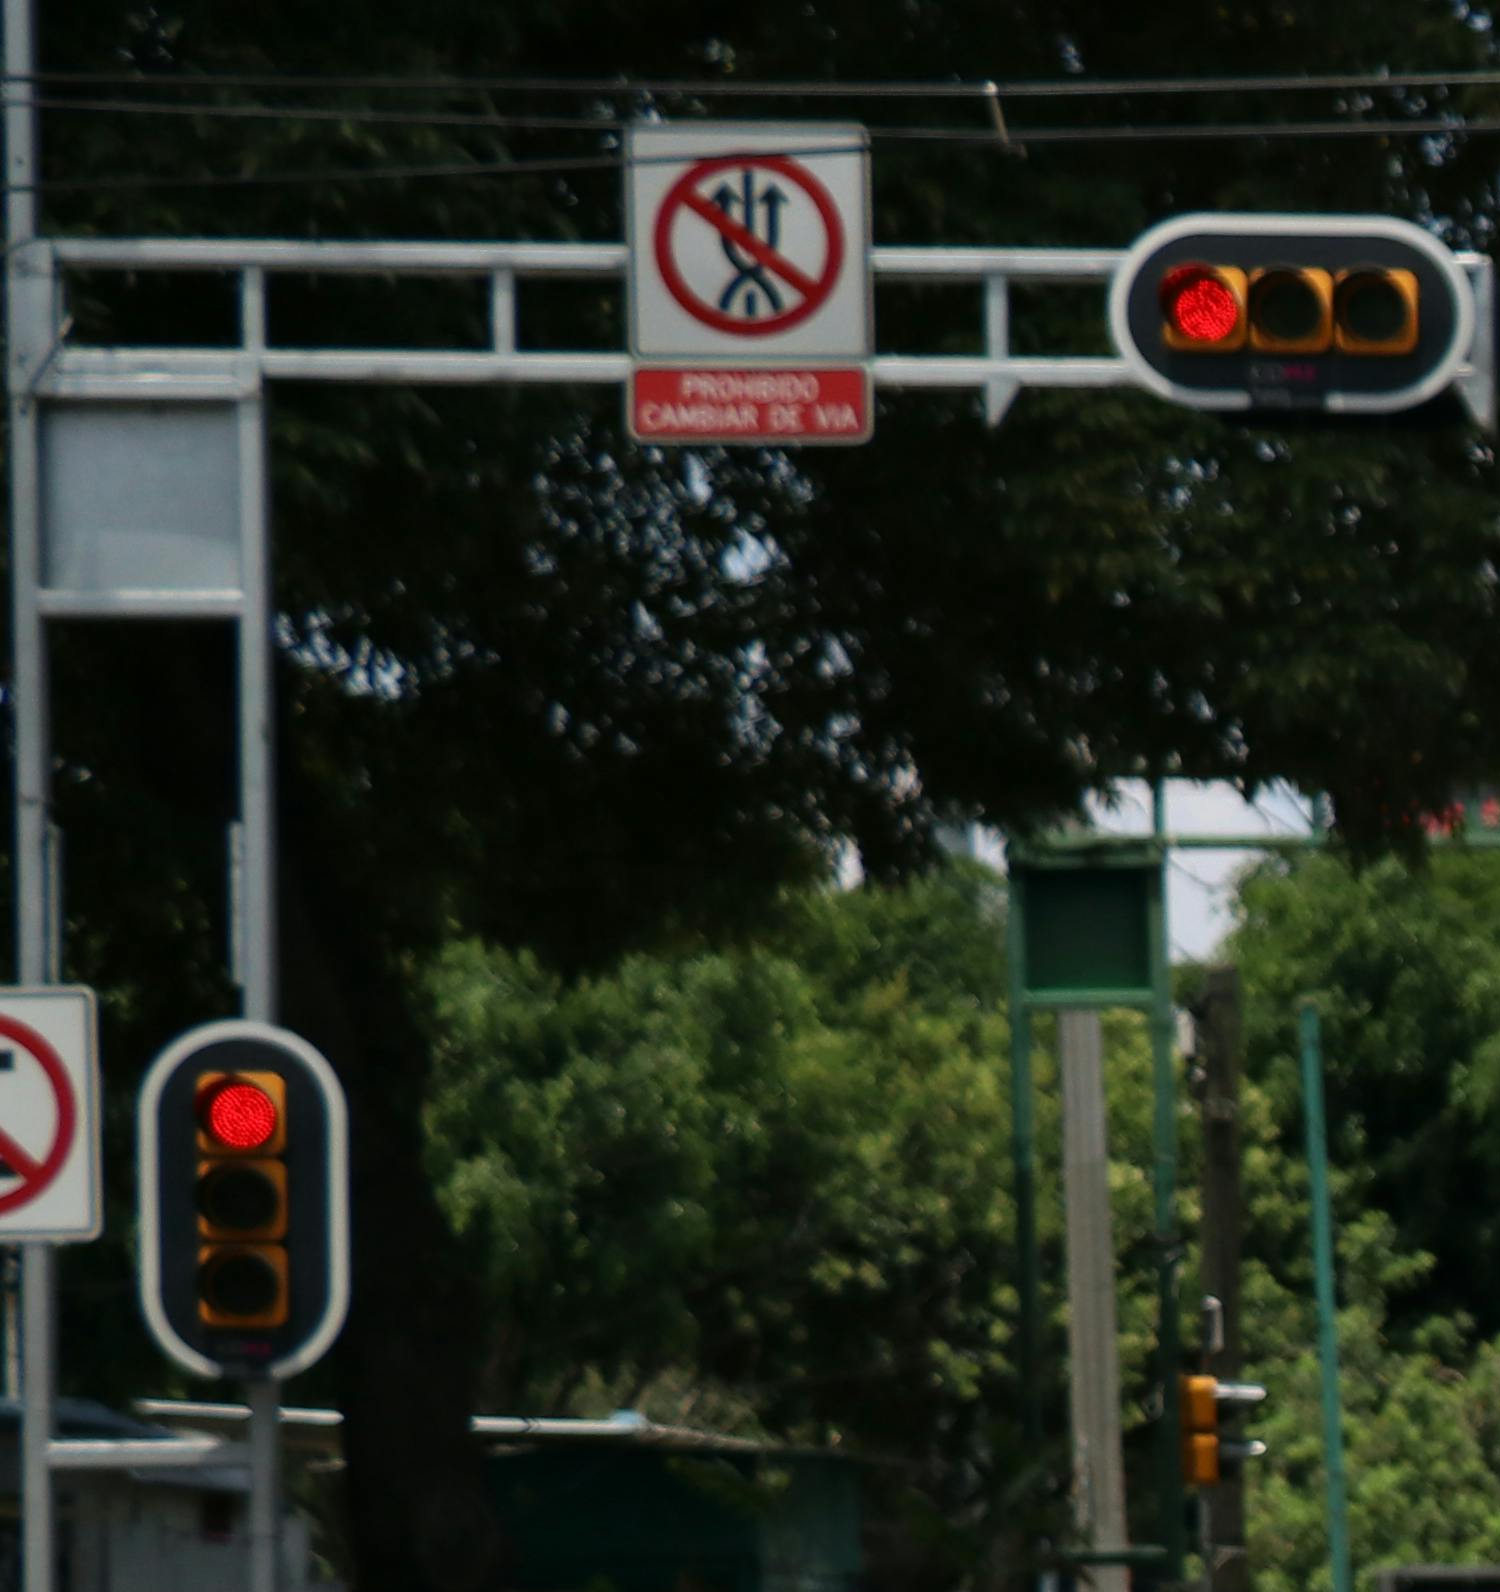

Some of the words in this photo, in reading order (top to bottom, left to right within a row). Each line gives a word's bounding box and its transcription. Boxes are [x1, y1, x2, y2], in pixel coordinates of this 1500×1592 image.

[681, 373, 820, 401] PROHIBIDO
[640, 402, 760, 431] CAMBIAR
[768, 402, 805, 431] DE
[814, 402, 860, 430] VIA
